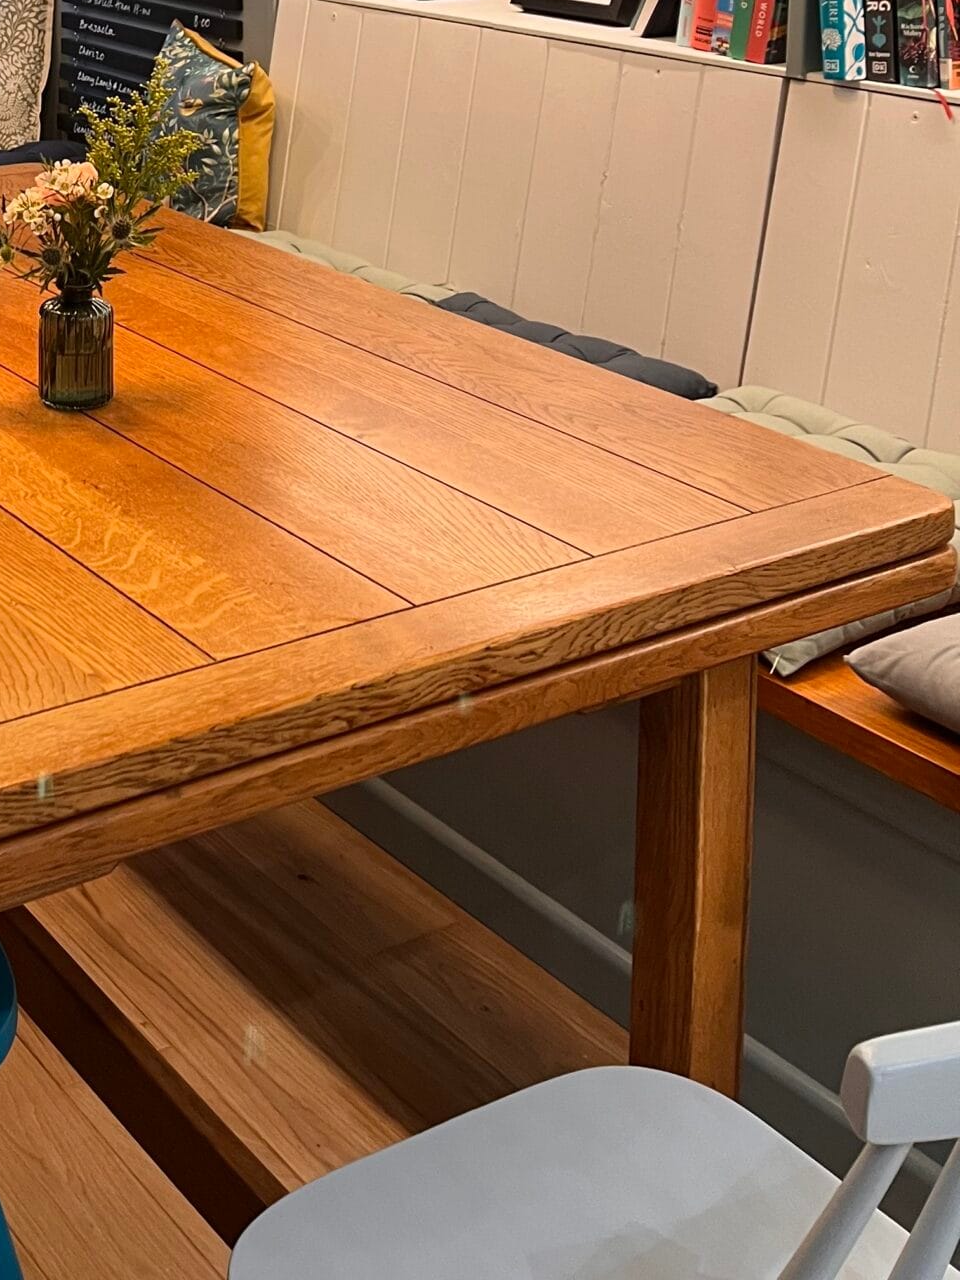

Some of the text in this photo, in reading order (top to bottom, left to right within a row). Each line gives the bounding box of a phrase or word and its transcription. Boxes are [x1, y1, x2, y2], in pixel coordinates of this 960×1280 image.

[754, 2, 768, 38] WORLD
[78, 45, 105, 60] Chorizo
[872, 61, 887, 73] DK
